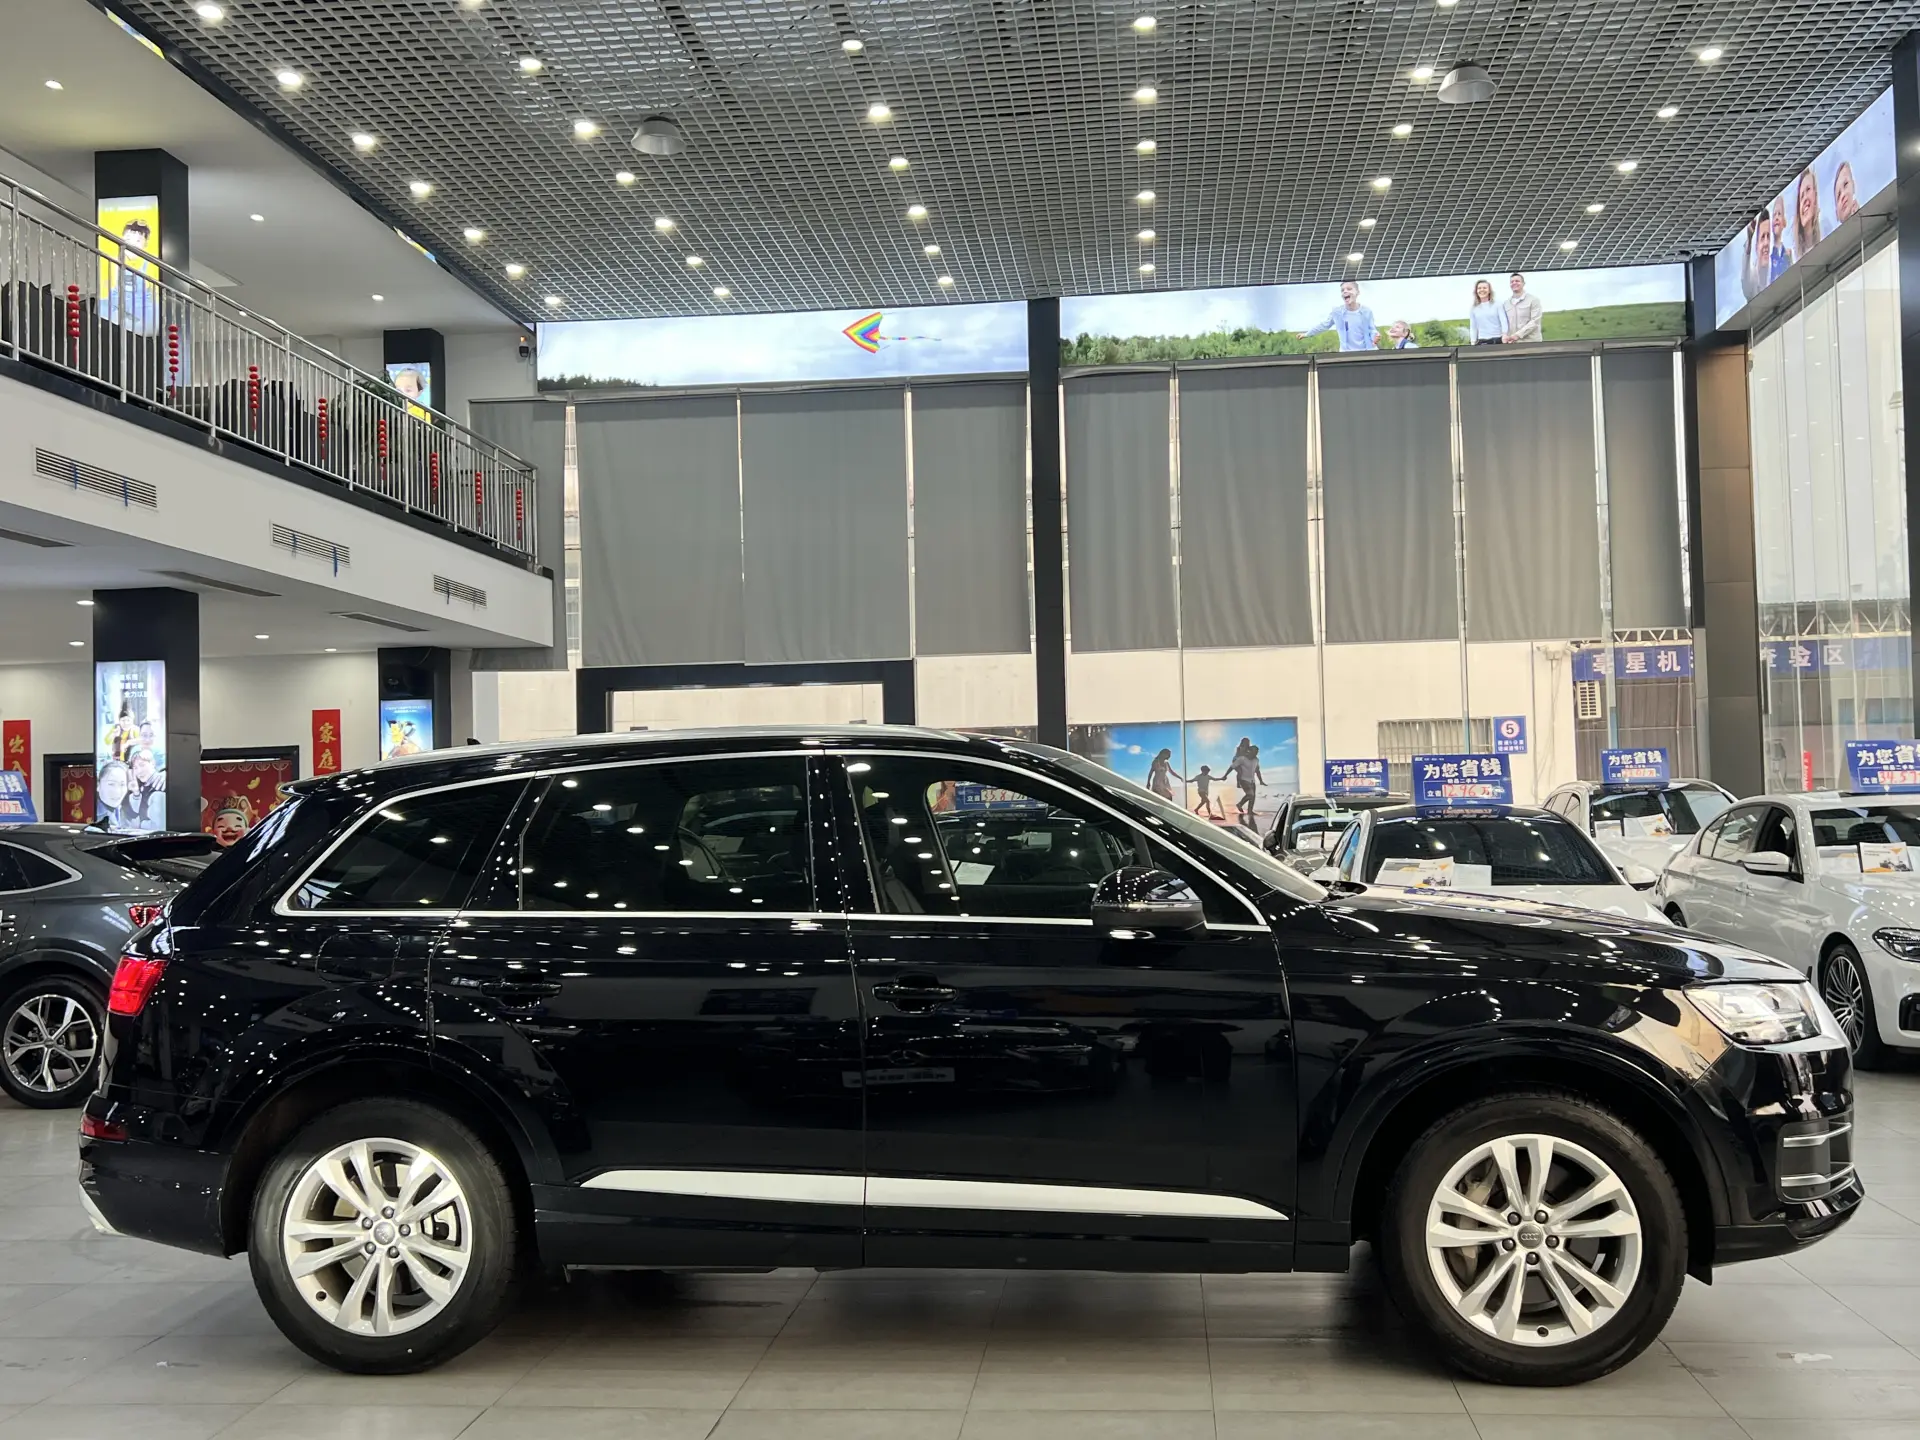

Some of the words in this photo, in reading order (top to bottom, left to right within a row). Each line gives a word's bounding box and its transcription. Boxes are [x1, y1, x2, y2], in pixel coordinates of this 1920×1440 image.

[1506, 723, 1515, 735] 5
[318, 722, 337, 770] 家庭
[1857, 744, 1920, 767] 为您省
[1609, 750, 1663, 766] 为您省钱
[1331, 761, 1383, 776] 为您省钱
[1423, 758, 1502, 780] 为您省钱
